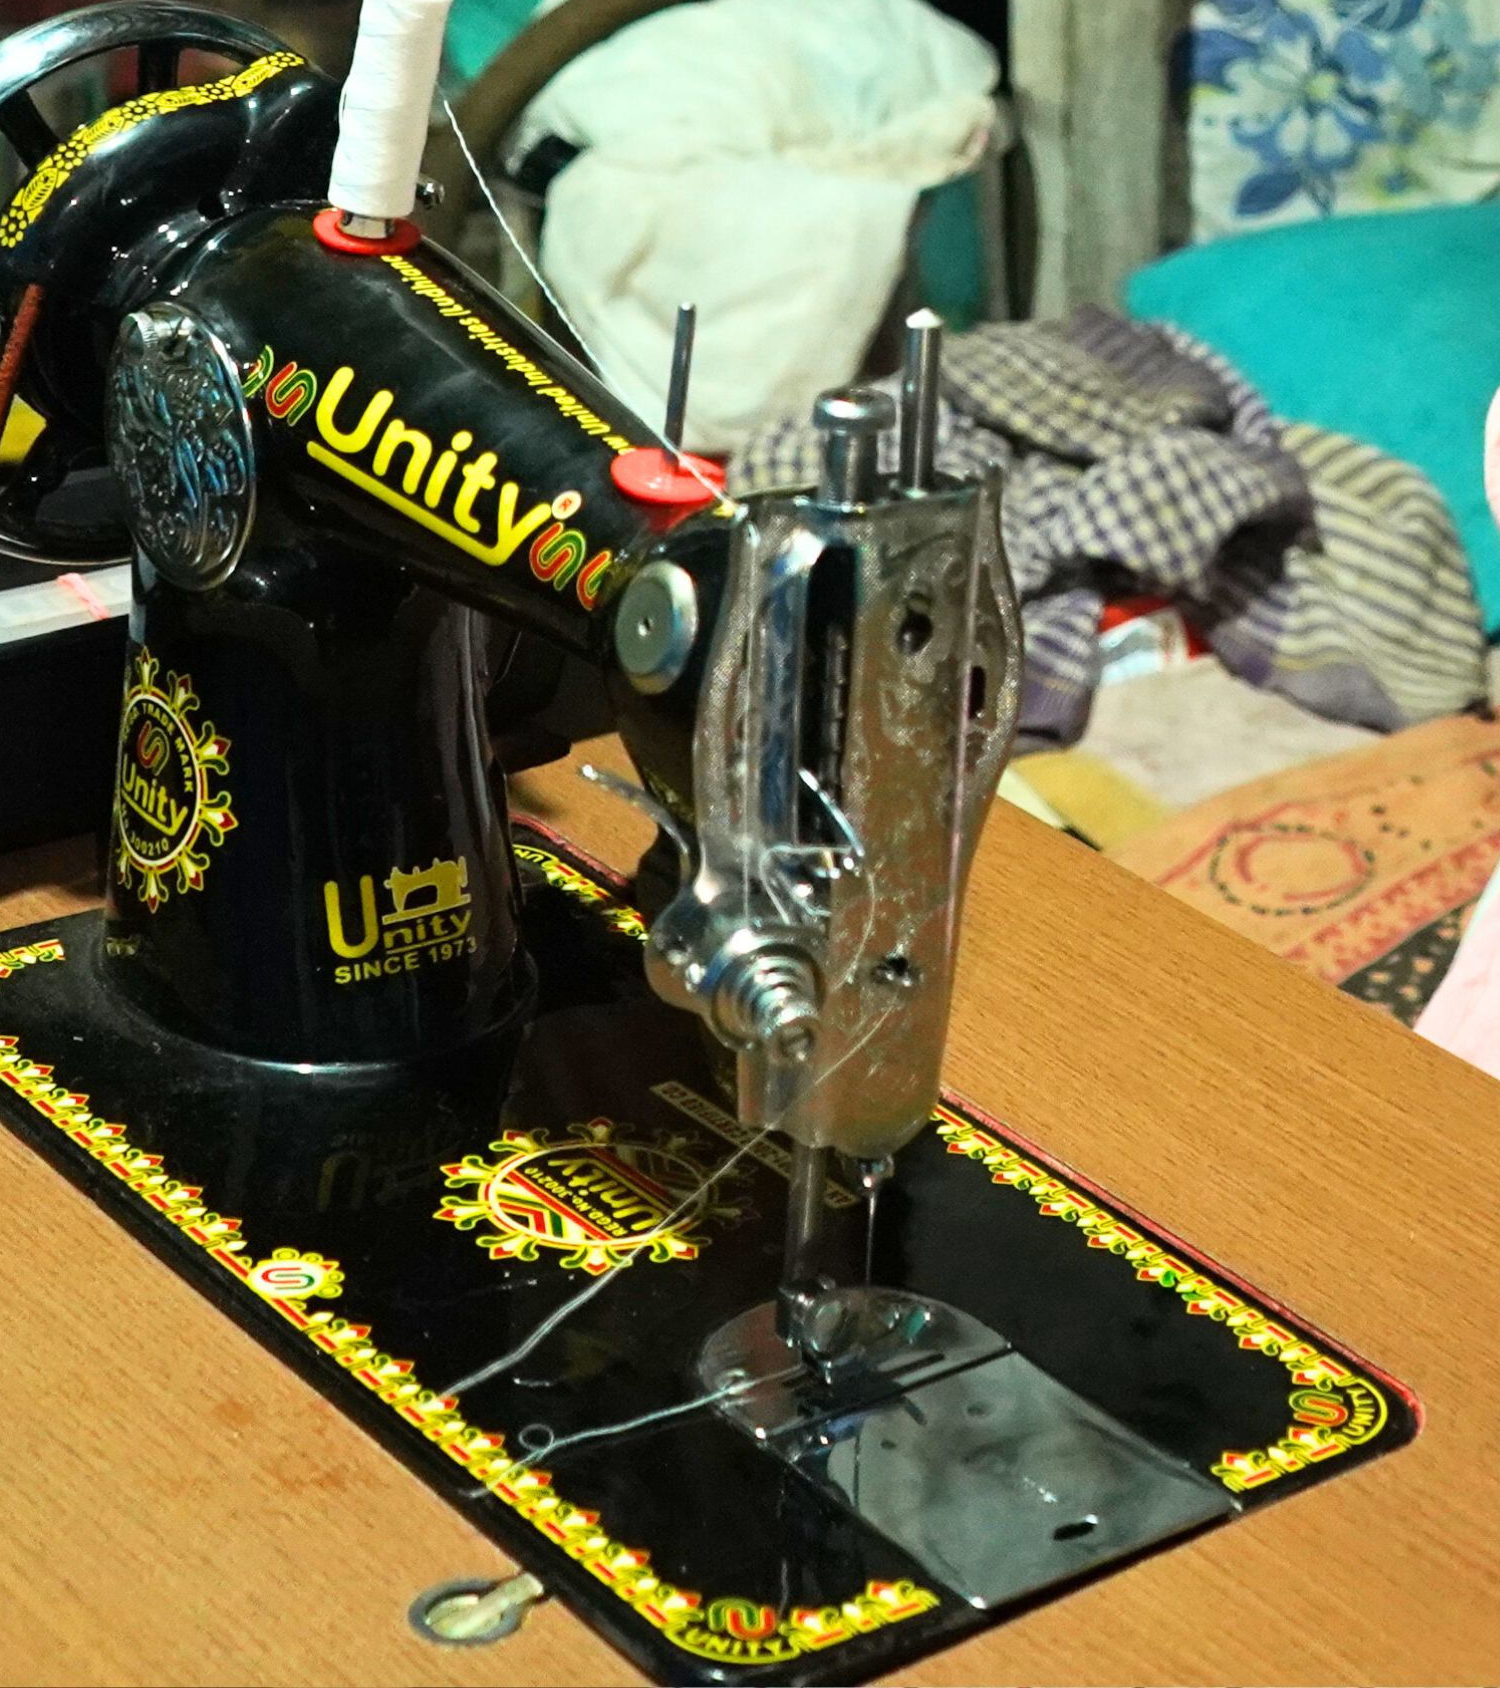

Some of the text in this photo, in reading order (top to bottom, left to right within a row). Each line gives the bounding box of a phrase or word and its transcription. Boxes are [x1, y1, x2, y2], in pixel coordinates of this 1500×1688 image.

[458, 316, 553, 386] Industries
[536, 387, 611, 435] United
[307, 366, 552, 566] Unity
[142, 702, 194, 793] TRADE MARK
[121, 753, 188, 836] Unity
[324, 874, 473, 959] Unity
[334, 936, 478, 985] SINCE 1973
[547, 1158, 666, 1231] Unity
[1342, 1387, 1376, 1437] UNITY
[685, 1627, 784, 1657] UNITY
